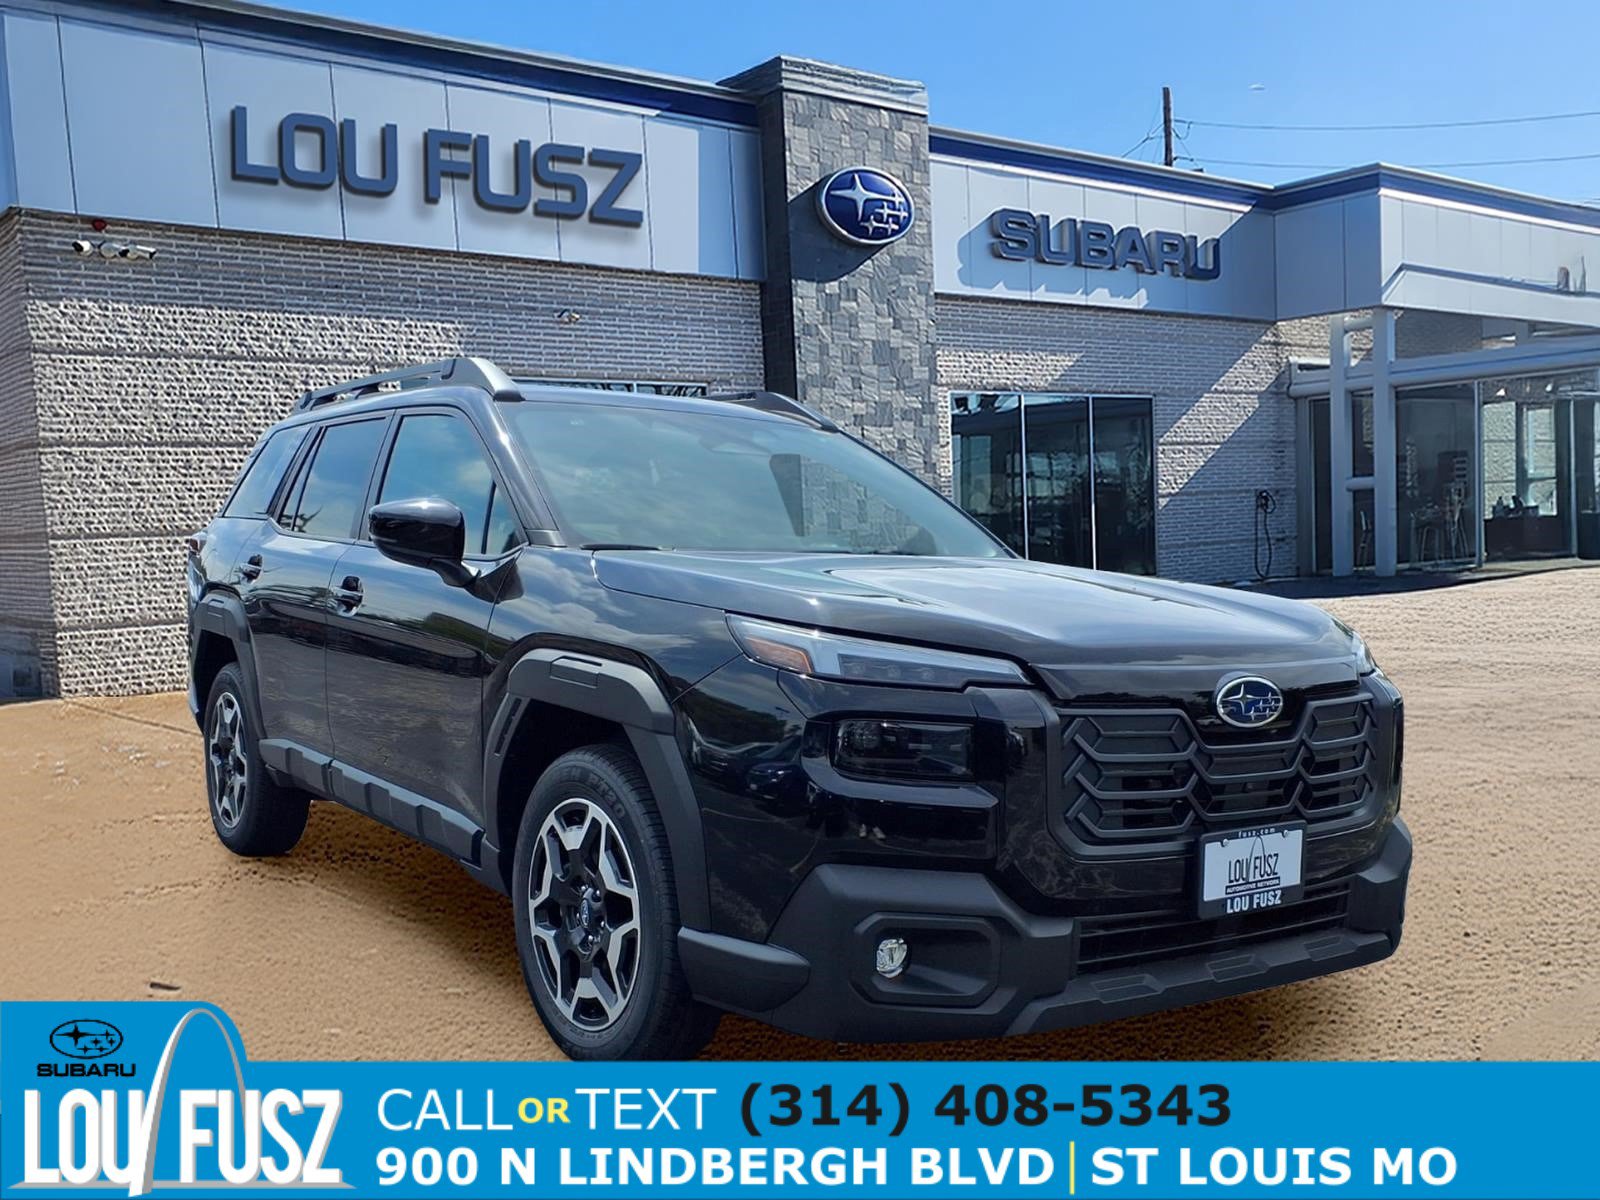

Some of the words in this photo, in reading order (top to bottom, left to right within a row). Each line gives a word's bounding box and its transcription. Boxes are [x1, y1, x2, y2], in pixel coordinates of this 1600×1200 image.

[231, 106, 398, 194] LOU
[424, 128, 643, 225] FUSZ
[992, 208, 1221, 280] SUBARU
[1228, 857, 1249, 883] LOU
[1253, 853, 1279, 879] FUSZ
[1226, 895, 1249, 914] LOU
[1253, 889, 1281, 908] FUSZ
